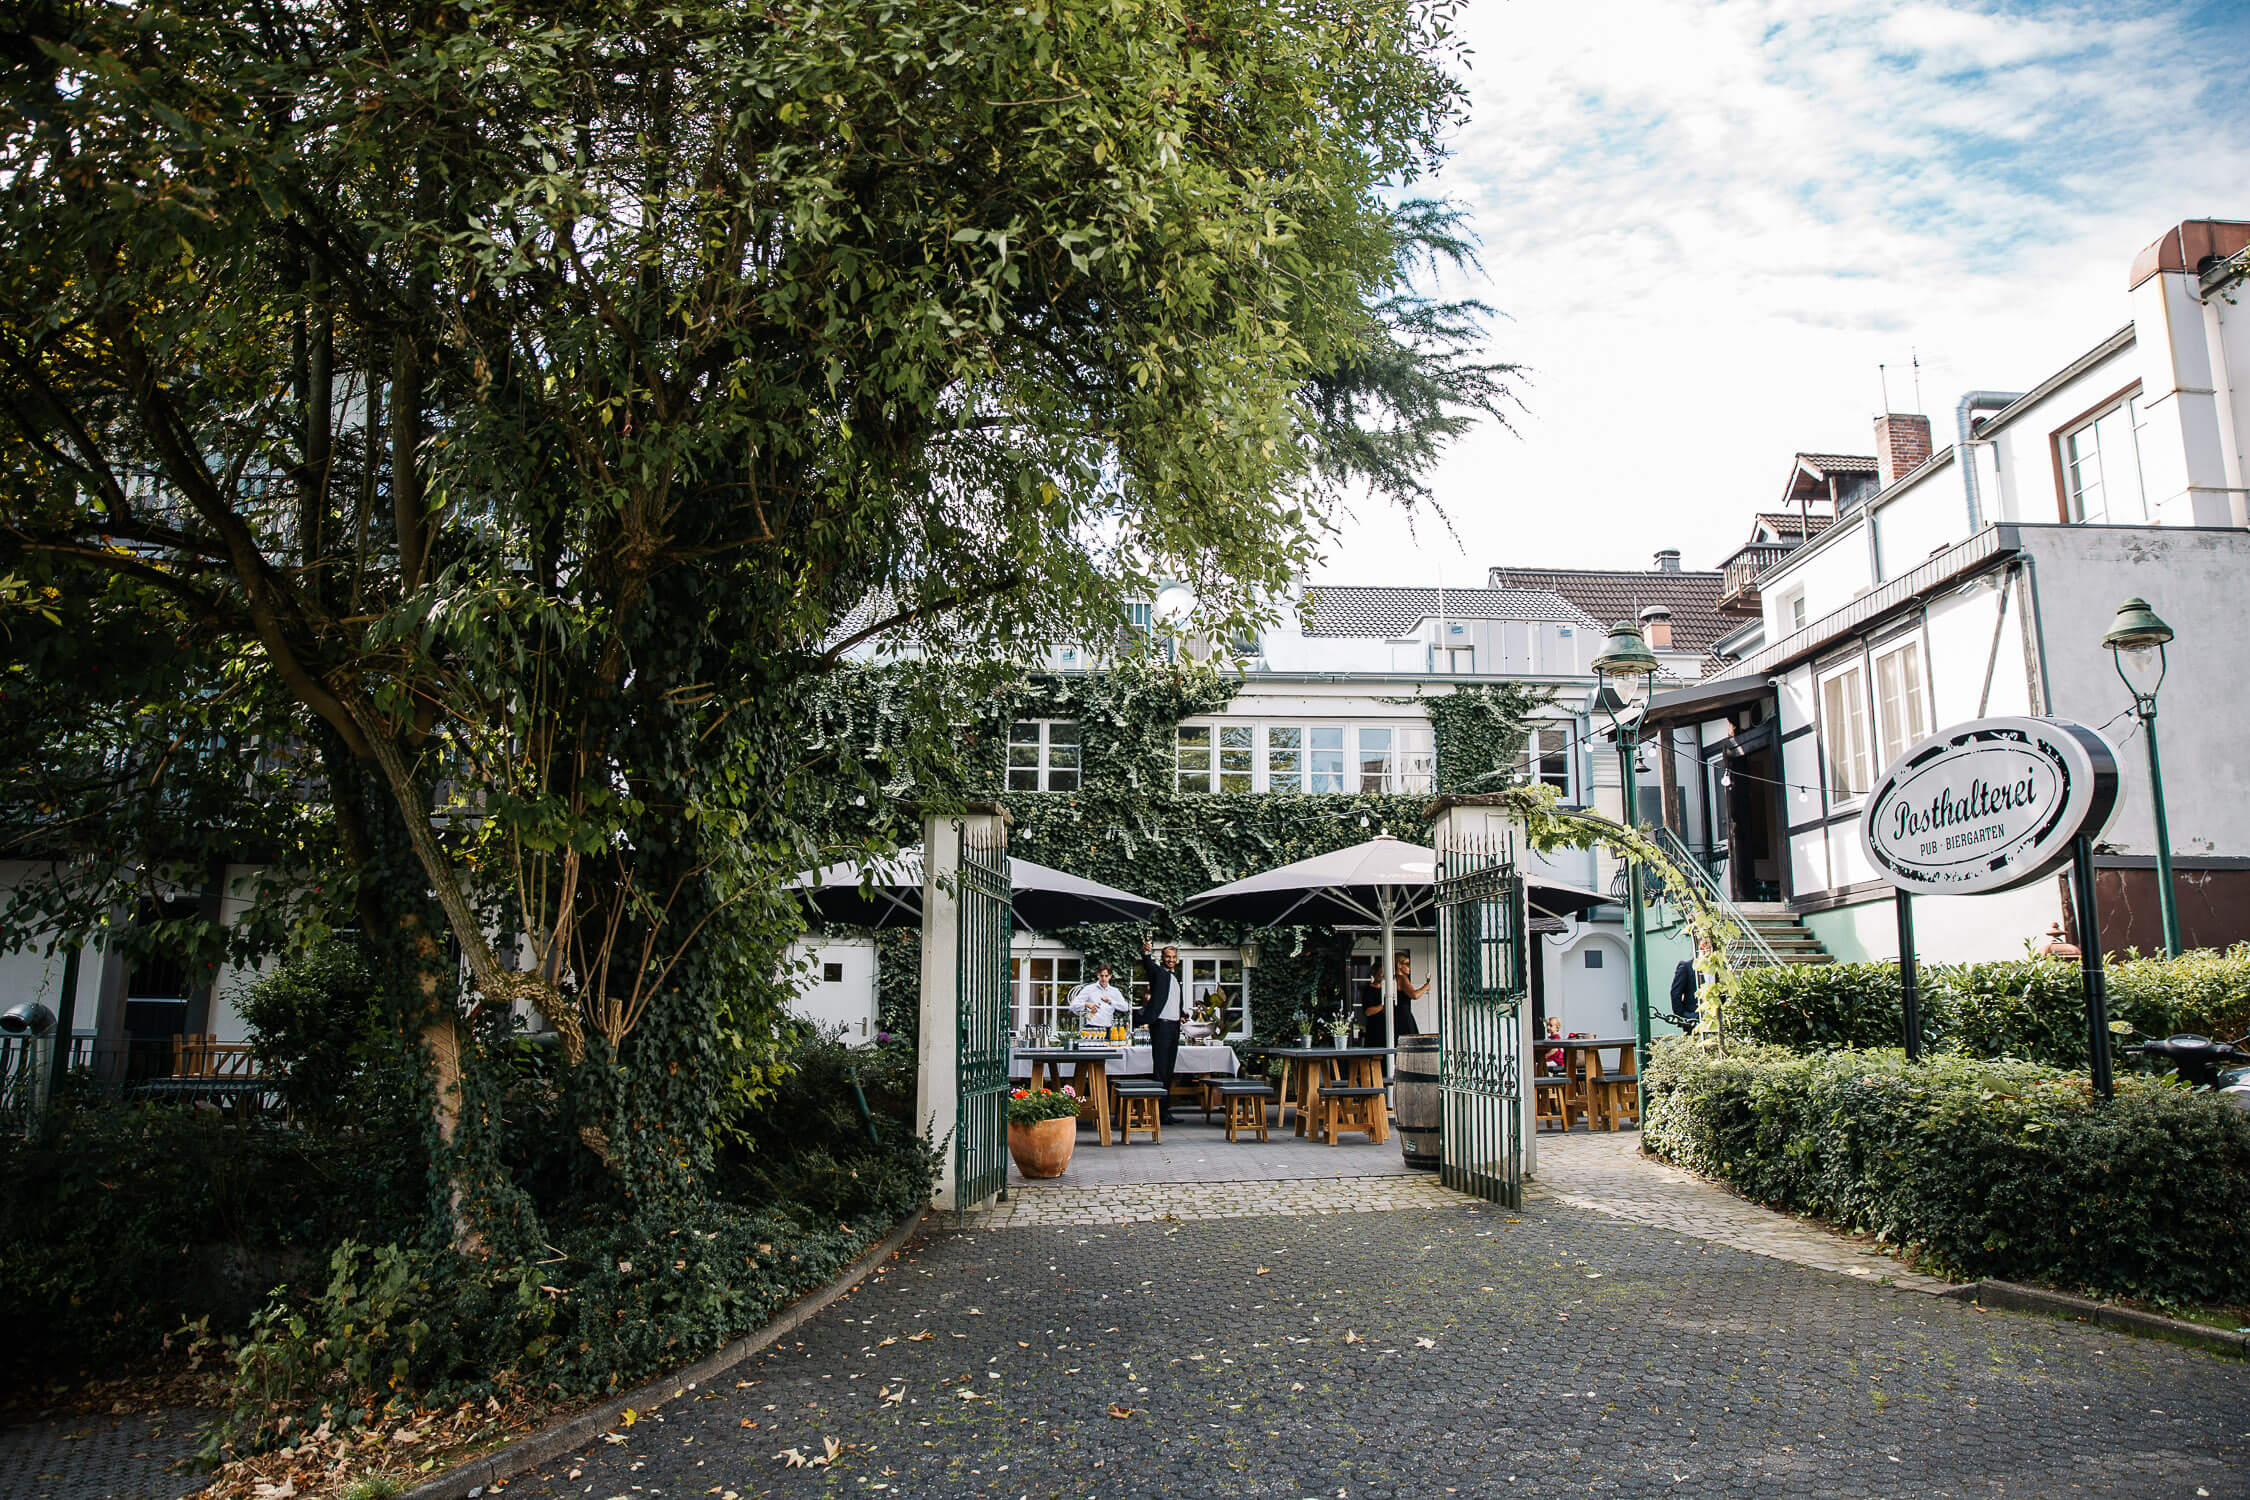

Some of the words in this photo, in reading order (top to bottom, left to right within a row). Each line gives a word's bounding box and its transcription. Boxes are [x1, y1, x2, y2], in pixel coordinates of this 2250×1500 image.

[1893, 766, 2037, 840] Posthalterei
[1919, 841, 1938, 857] PUB
[1945, 823, 2006, 850] BIERGARTEN
